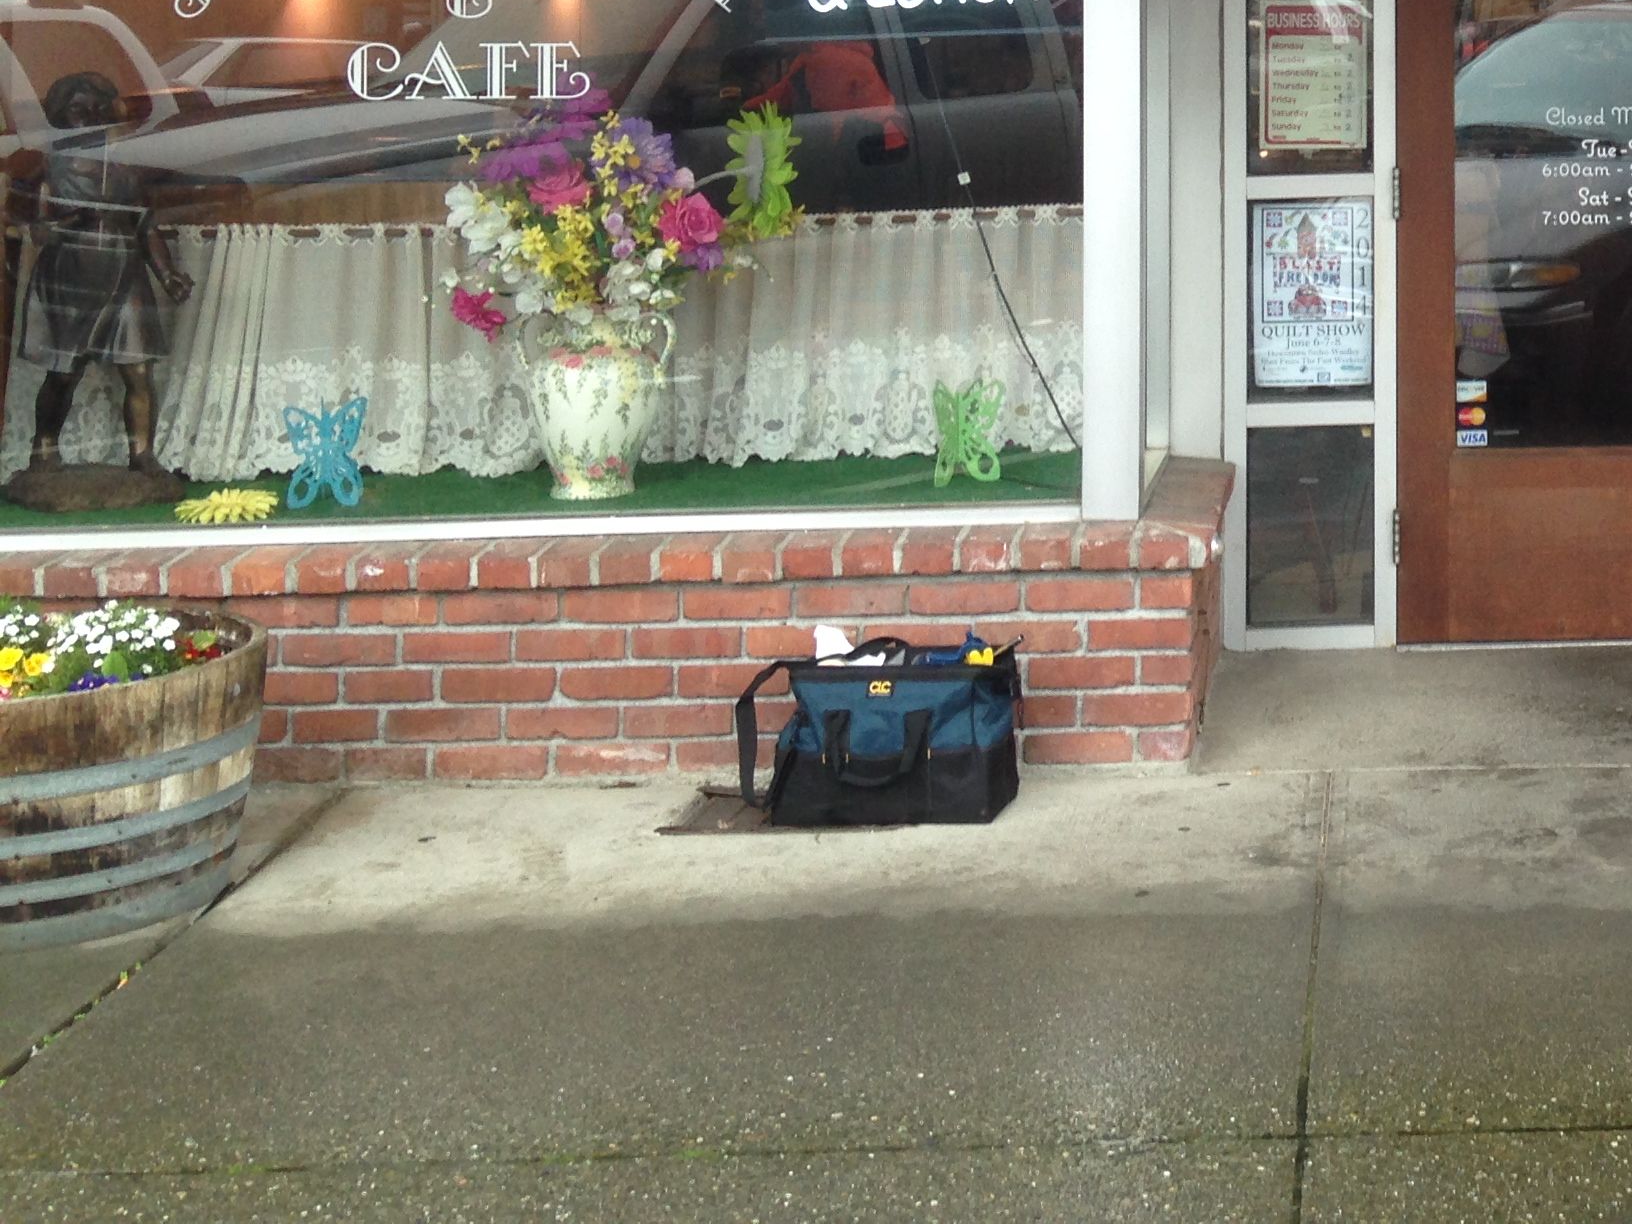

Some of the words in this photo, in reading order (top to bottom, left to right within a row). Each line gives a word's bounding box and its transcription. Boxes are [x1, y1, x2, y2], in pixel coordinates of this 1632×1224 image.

[1267, 12, 1320, 28] BUSINESS
[1323, 12, 1361, 28] HOURS
[1271, 41, 1304, 51] Monday
[1272, 55, 1306, 64] Tuesday
[346, 39, 591, 101] CAFE
[1272, 69, 1320, 78] Wednesday
[1272, 82, 1311, 91] Thursday
[1271, 95, 1297, 105] Friday
[1271, 109, 1309, 119] Saturday
[1546, 106, 1606, 126] Closed
[1271, 123, 1302, 132] Sunday
[1581, 138, 1616, 158] Tue
[1542, 162, 1611, 178] 6:00am
[1578, 186, 1609, 207] Sat
[1542, 210, 1610, 226] 7:00am
[1261, 323, 1313, 339] QUILT
[1316, 322, 1366, 337] SHOW
[1287, 337, 1310, 349] June
[1313, 337, 1341, 348] 6-7-8
[1460, 432, 1486, 444] VISA
